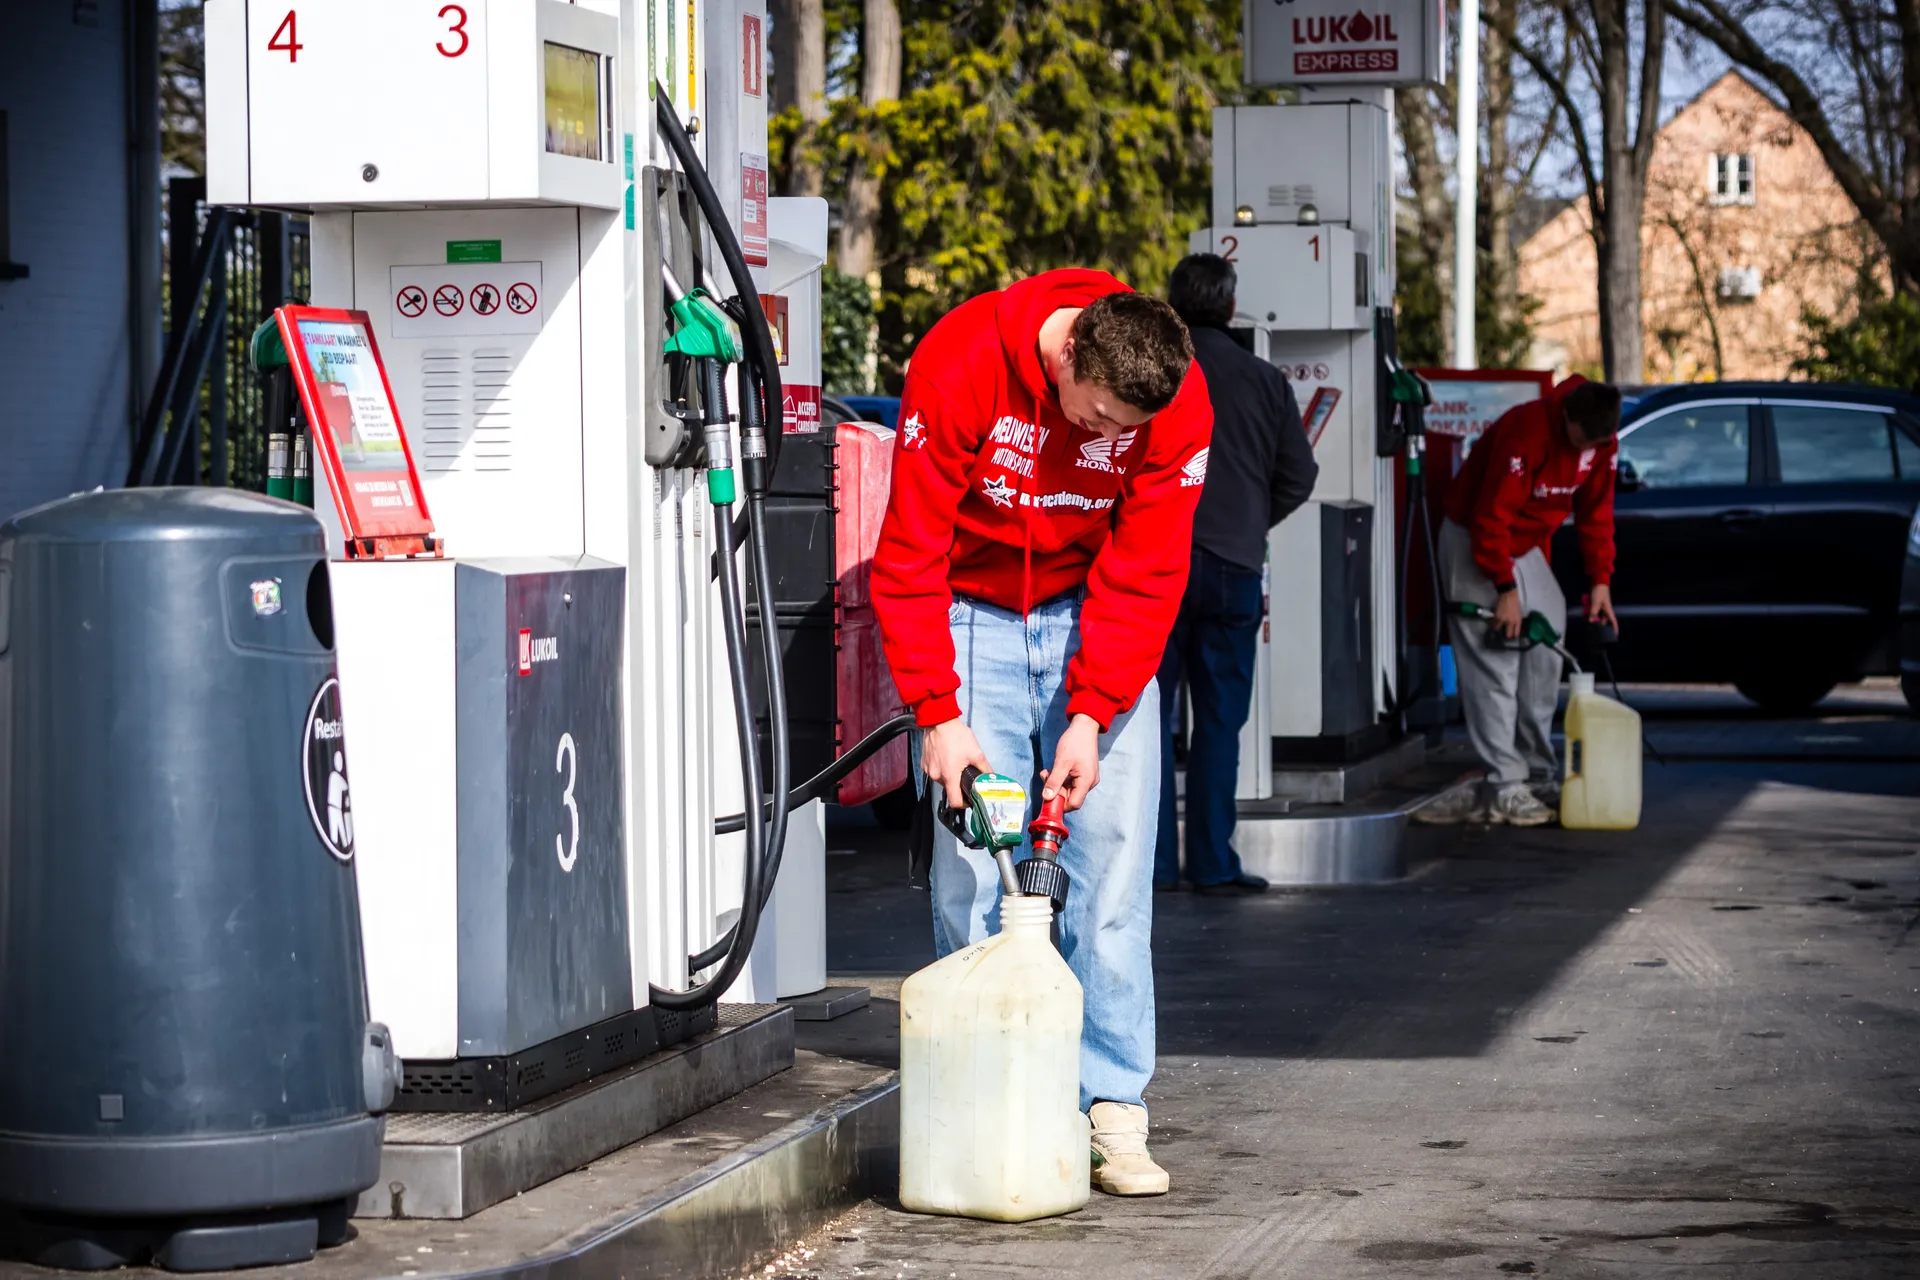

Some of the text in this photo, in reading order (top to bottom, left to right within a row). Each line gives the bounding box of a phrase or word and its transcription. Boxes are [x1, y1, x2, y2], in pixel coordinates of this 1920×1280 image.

[267, 10, 304, 63] 4
[436, 4, 469, 58] 3
[1292, 9, 1398, 44] LUKOIL
[1297, 52, 1395, 71] EXPRESS
[1220, 235, 1238, 263] 2
[1308, 234, 1320, 262] 1
[1423, 400, 1477, 415] ANK-
[988, 416, 1050, 454] MEUWISN
[1180, 475, 1205, 487] HO
[531, 637, 558, 662] LUKOIL
[314, 717, 343, 740] Resta
[556, 733, 580, 873] 3
